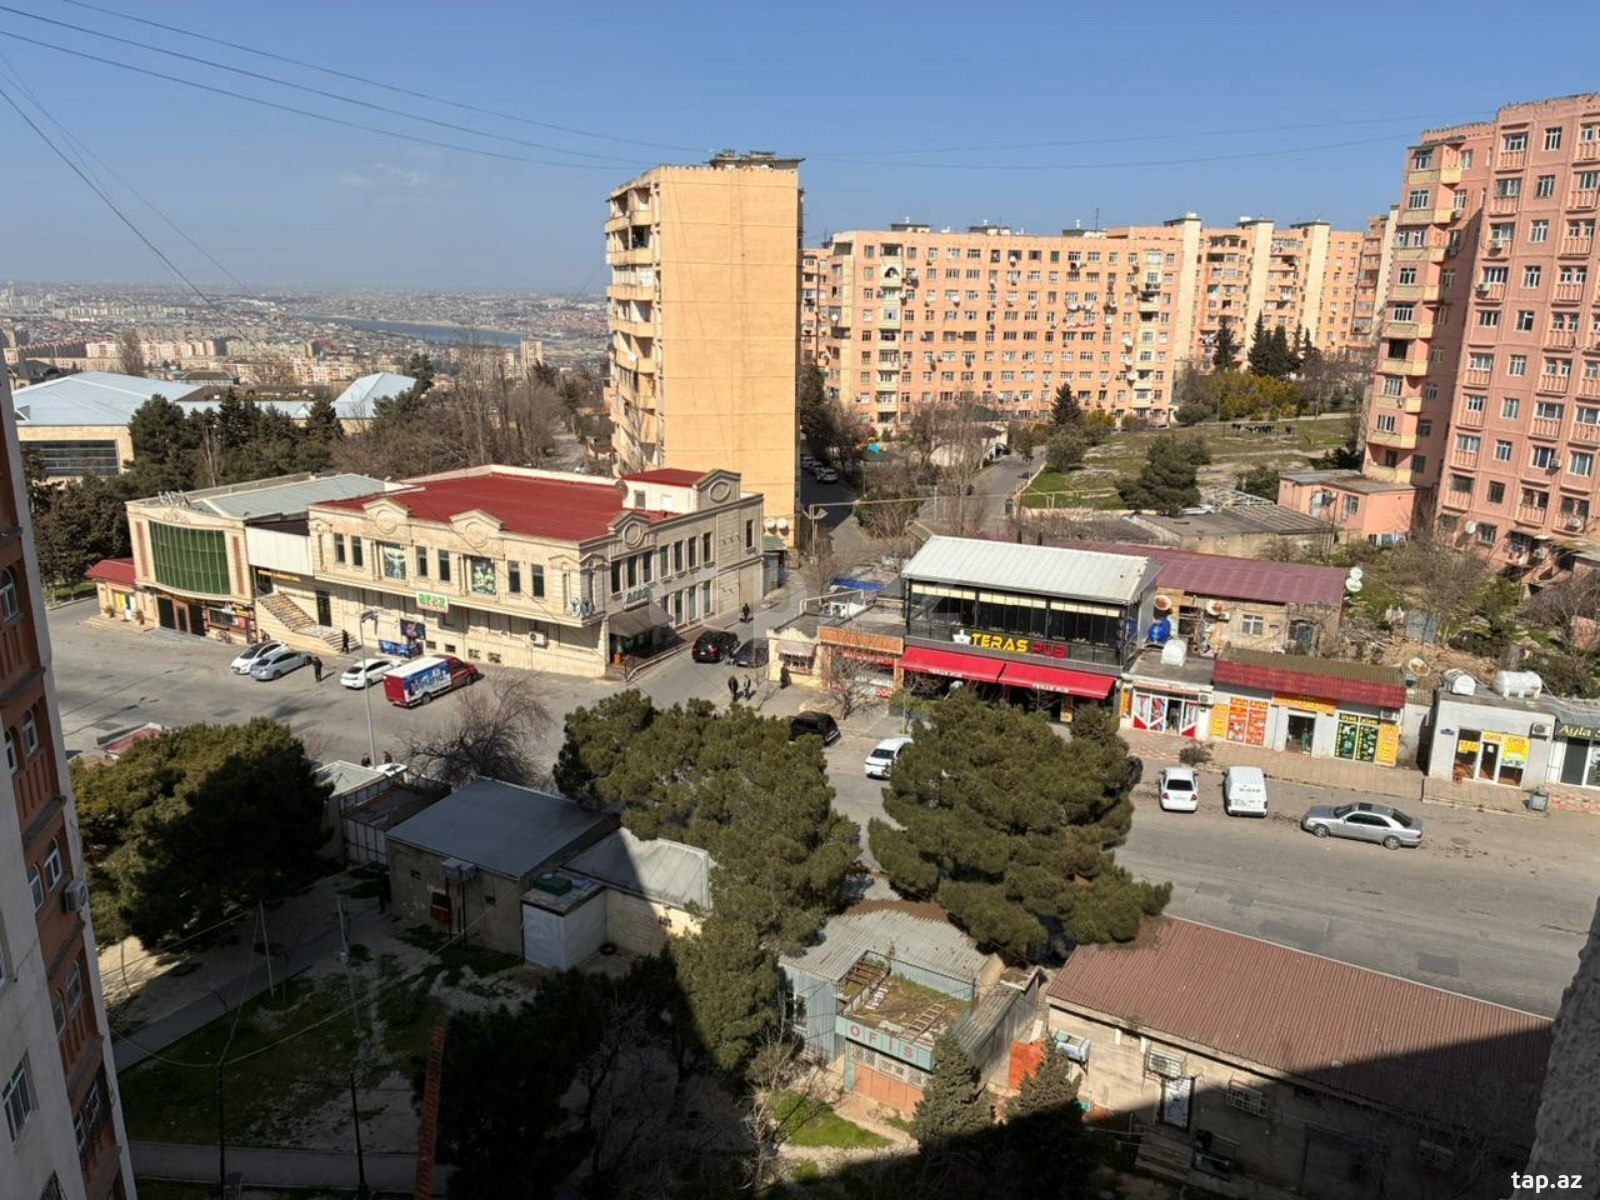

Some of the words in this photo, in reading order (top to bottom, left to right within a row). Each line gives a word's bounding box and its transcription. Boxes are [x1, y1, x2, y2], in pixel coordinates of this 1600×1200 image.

[970, 633, 1029, 654] TERAS
[1031, 641, 1069, 659] PUB
[1559, 725, 1591, 737] Ayla
